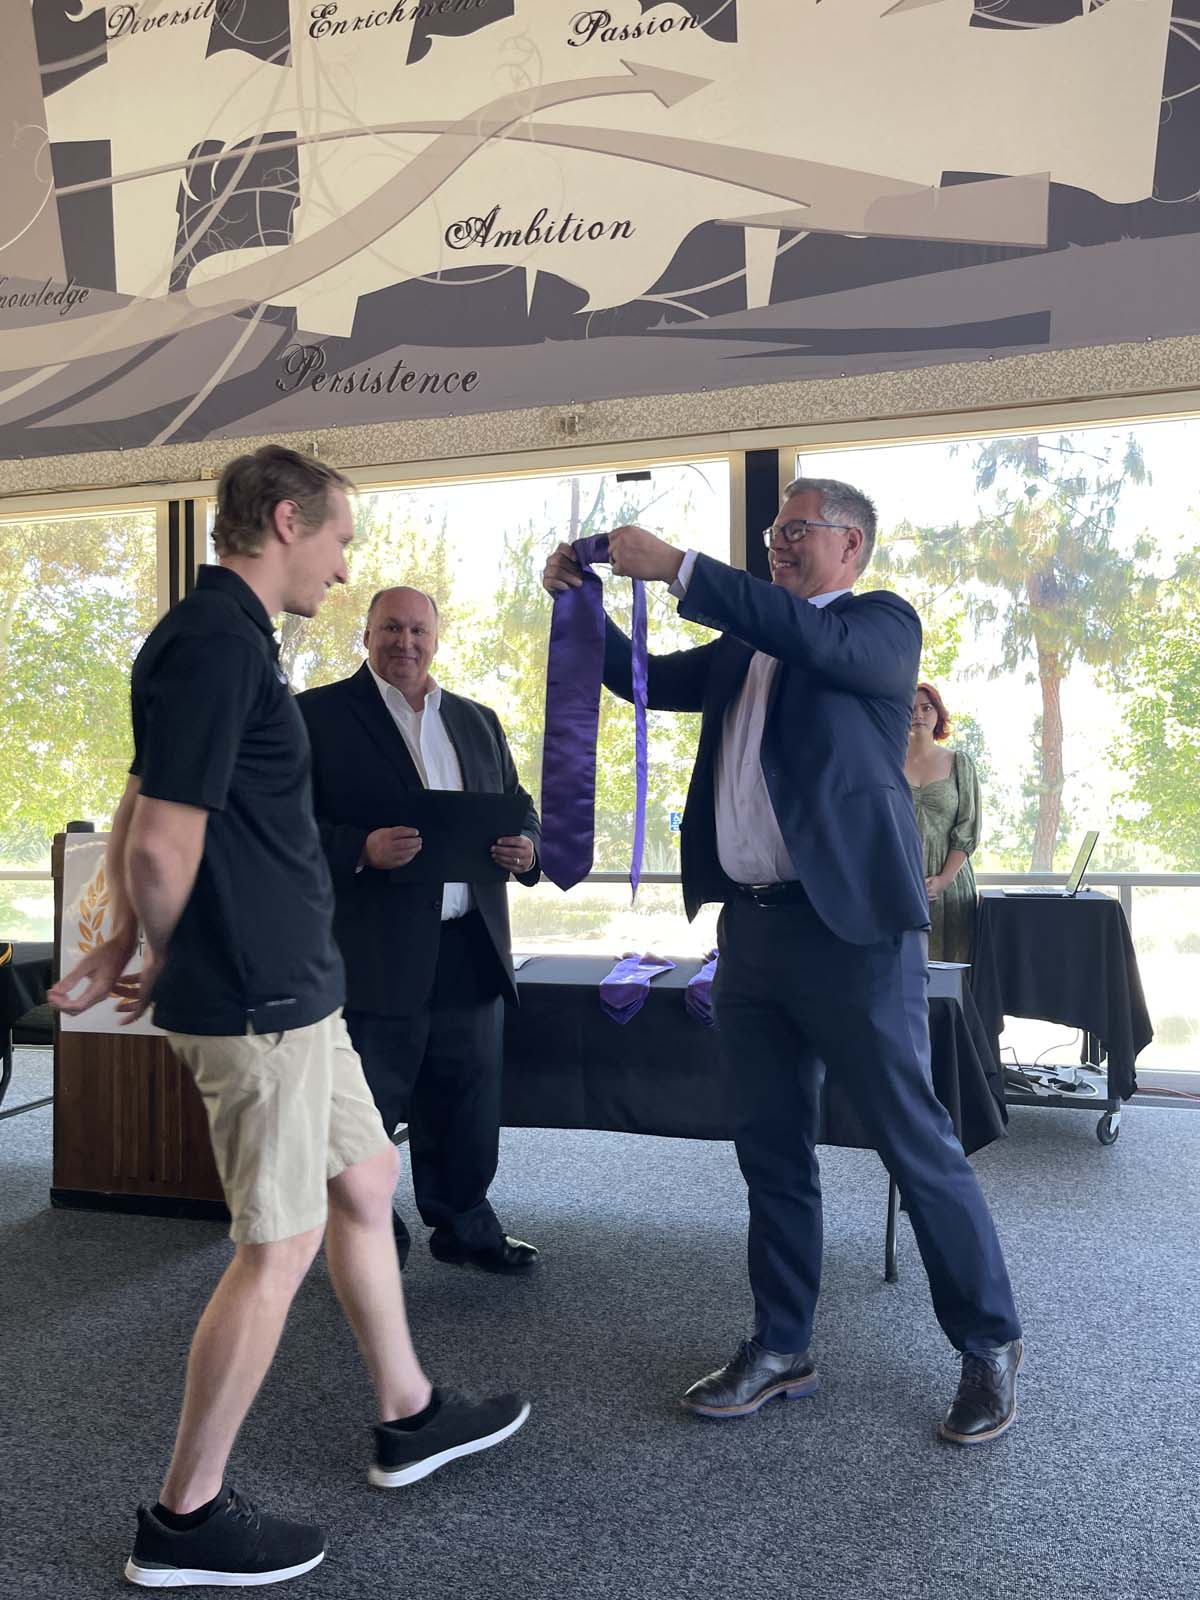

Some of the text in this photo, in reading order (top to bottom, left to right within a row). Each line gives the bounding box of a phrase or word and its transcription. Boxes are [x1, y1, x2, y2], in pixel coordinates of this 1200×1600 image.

[567, 9, 700, 47] Passion
[444, 204, 637, 250] Ambition
[0, 276, 90, 315] nowledge
[276, 344, 480, 394] Persistence
